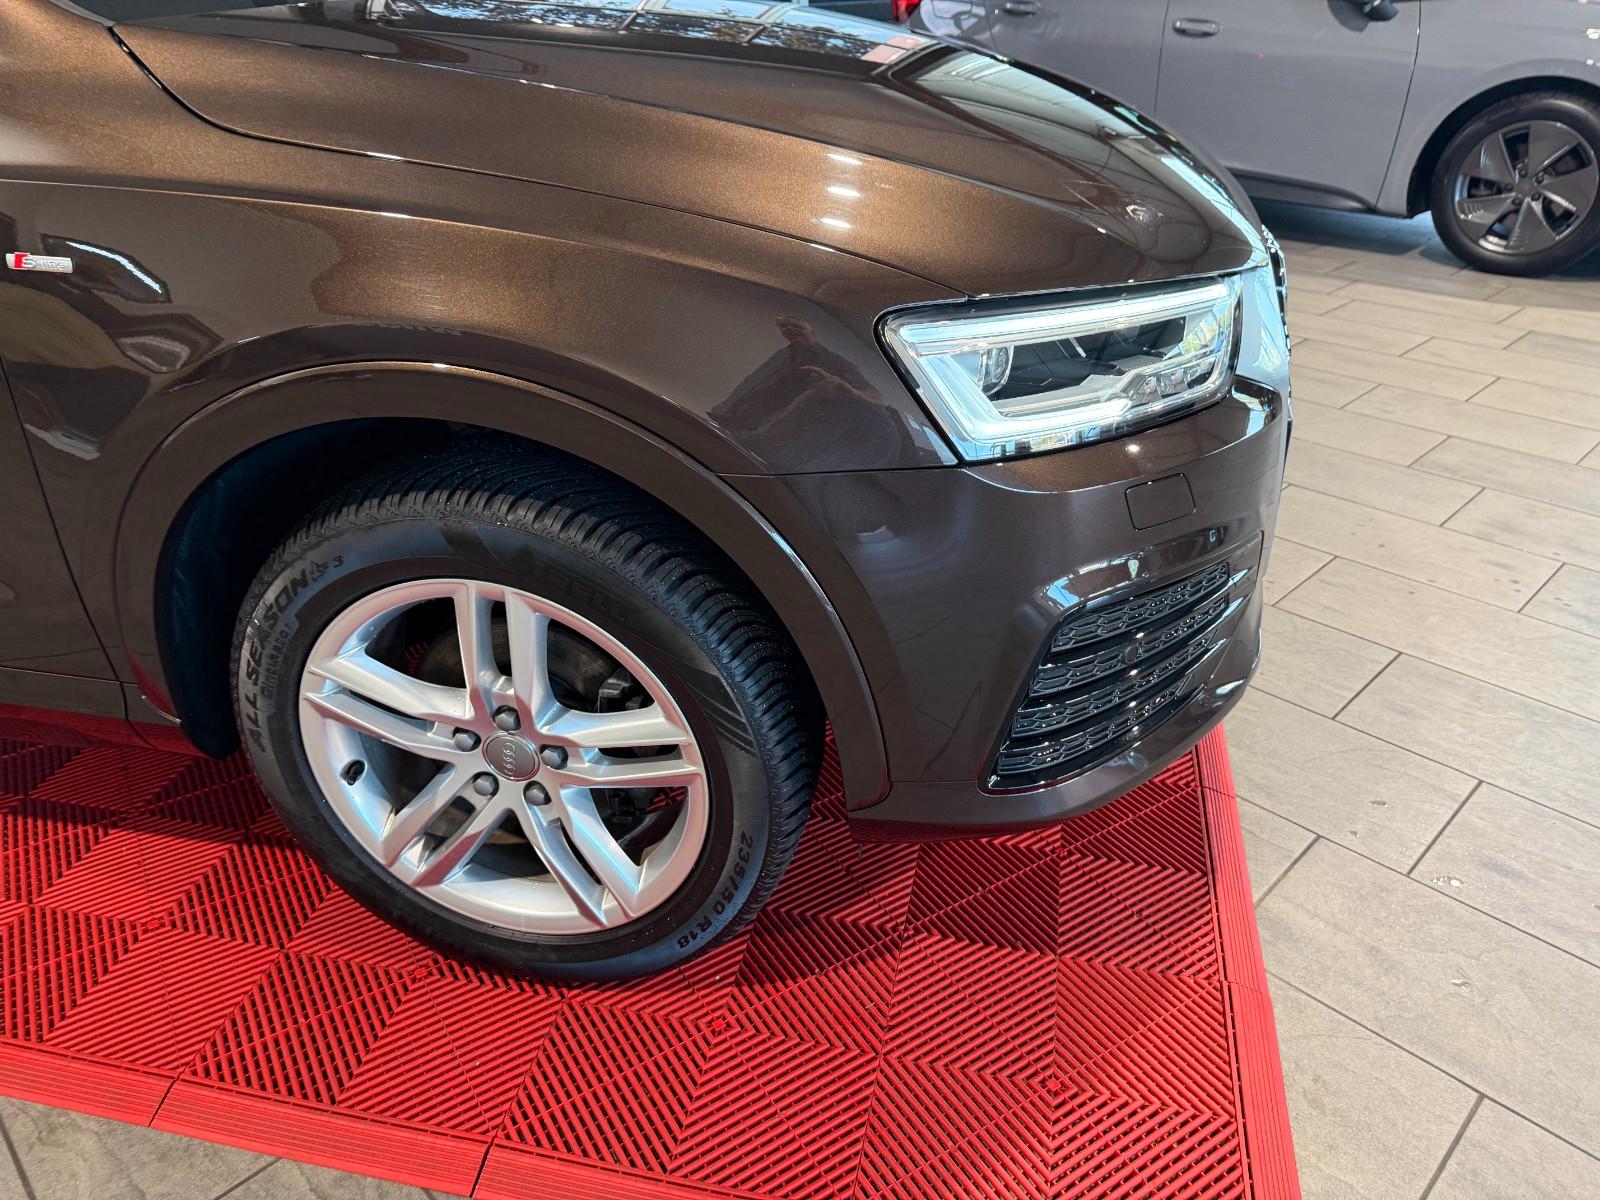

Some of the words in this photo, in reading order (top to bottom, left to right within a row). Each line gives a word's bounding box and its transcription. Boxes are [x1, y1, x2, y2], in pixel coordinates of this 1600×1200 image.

[19, 254, 36, 269] S
[245, 692, 266, 753] ALL
[332, 555, 344, 568] 3
[713, 830, 753, 915] 235/50
[677, 915, 713, 949] R18
